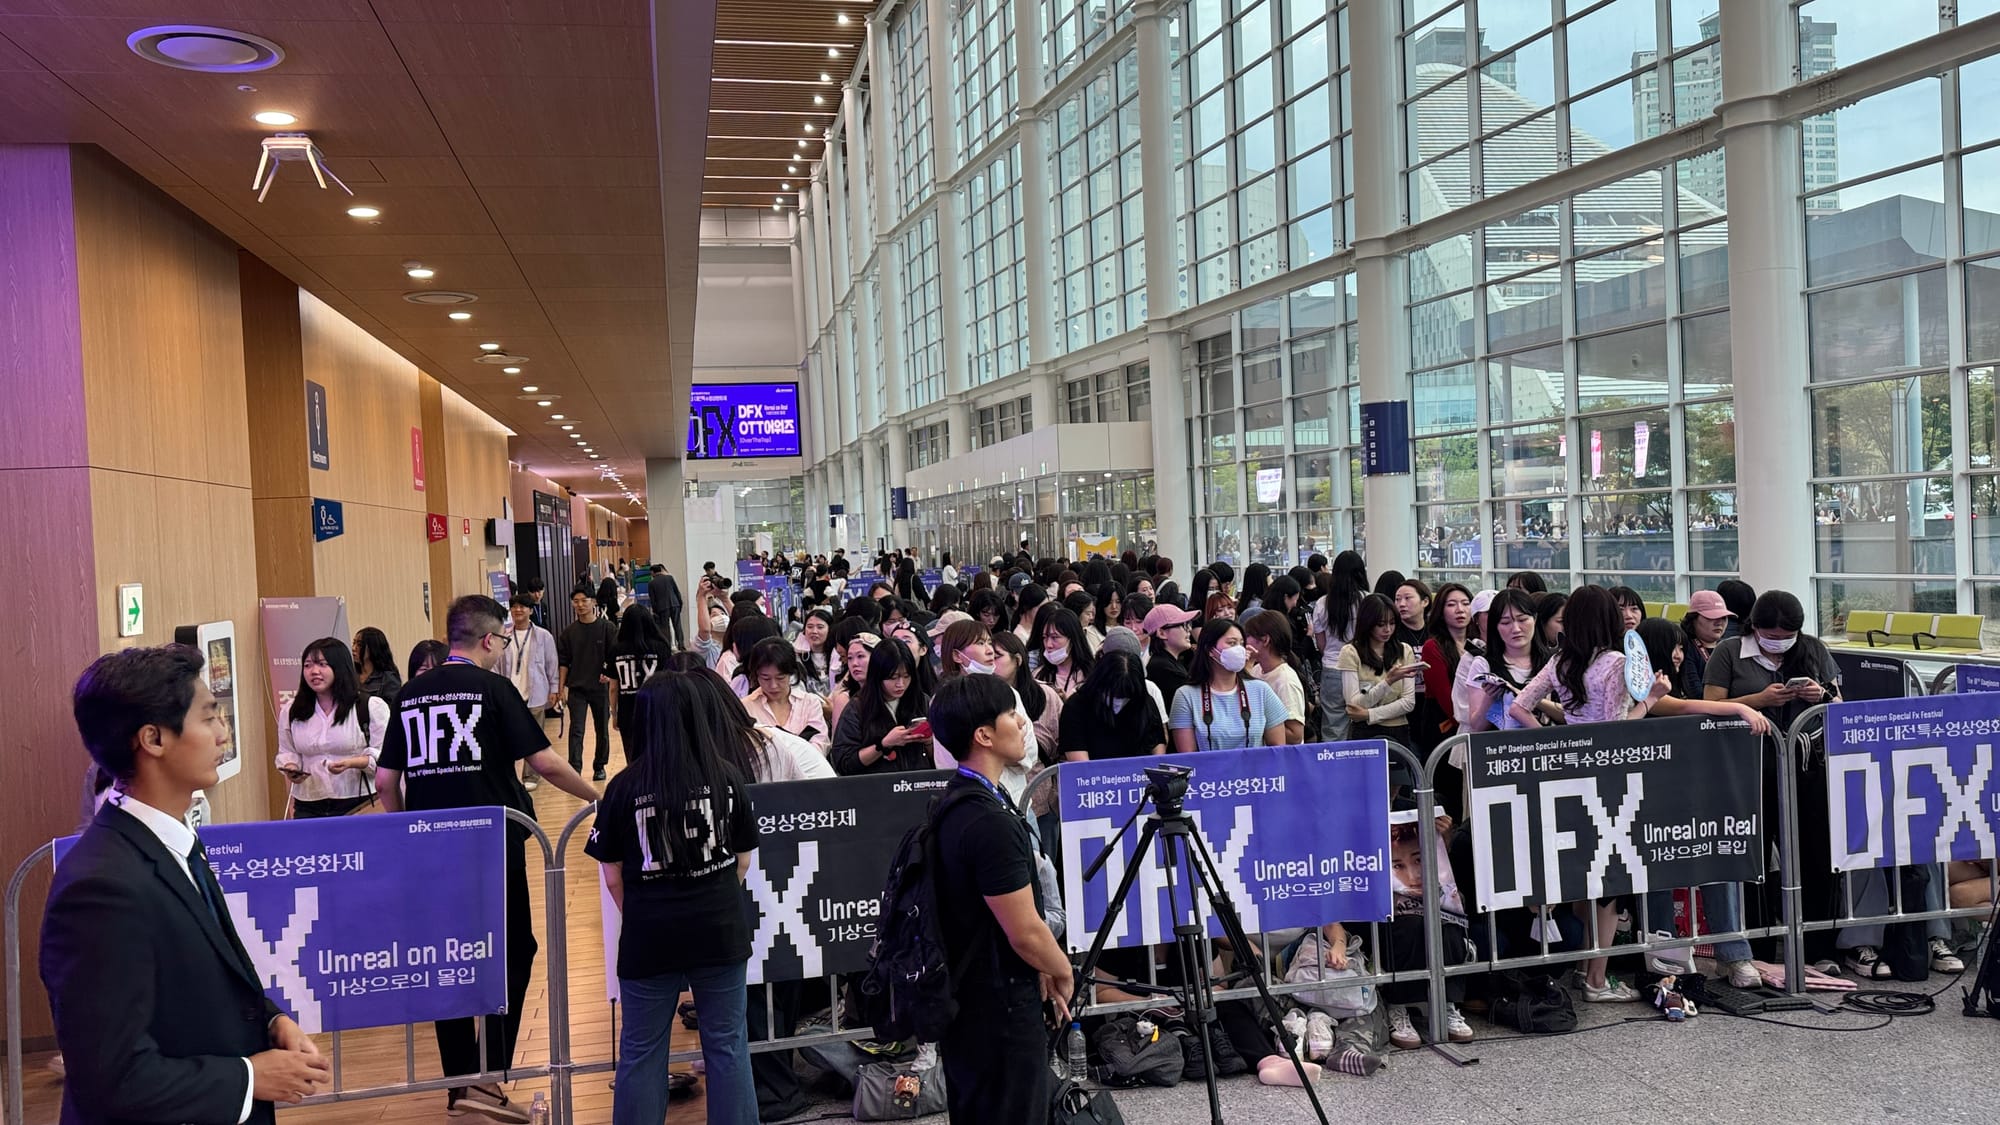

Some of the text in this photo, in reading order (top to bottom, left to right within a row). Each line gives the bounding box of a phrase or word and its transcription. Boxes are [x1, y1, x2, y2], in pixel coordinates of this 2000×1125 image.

[738, 404, 763, 418] DFX
[1453, 548, 1473, 566] DFX
[1701, 719, 1716, 730] DFX
[1842, 716, 1853, 725] The
[1864, 713, 1888, 724] Daejeon
[1889, 711, 1911, 722] Special
[1912, 711, 1920, 719] Fx
[1920, 709, 1944, 719] Festival
[400, 704, 482, 767] DFX
[1842, 727, 1880, 745] 제8회
[1317, 749, 1335, 761] DFX
[1485, 746, 1497, 755] The
[1508, 743, 1535, 754] Daejeon
[1536, 740, 1559, 751] Special
[1560, 740, 1567, 748] Fx
[1568, 738, 1593, 748] Festival
[1486, 744, 1672, 776] 제8회 대전특수영상영화제
[893, 780, 912, 792] DFX
[1076, 777, 1090, 787] The
[1102, 775, 1131, 786] Daejeon
[1077, 789, 1122, 809] 제8회
[1830, 744, 1996, 873] DFX
[409, 819, 431, 833] DFX
[1643, 814, 1757, 844] Unreal on Real
[205, 843, 243, 856] Festival
[1472, 771, 1648, 913] DFX
[1650, 840, 1747, 863] 가상으로의 몰입
[1254, 848, 1383, 882] Unreal on Real
[1063, 805, 1260, 954] DFX
[1263, 876, 1369, 902] 가상으로의 몰입
[818, 891, 885, 922] Unrea
[318, 931, 493, 975] Unreal on Real
[328, 966, 477, 998] 가상으로의 몰입
